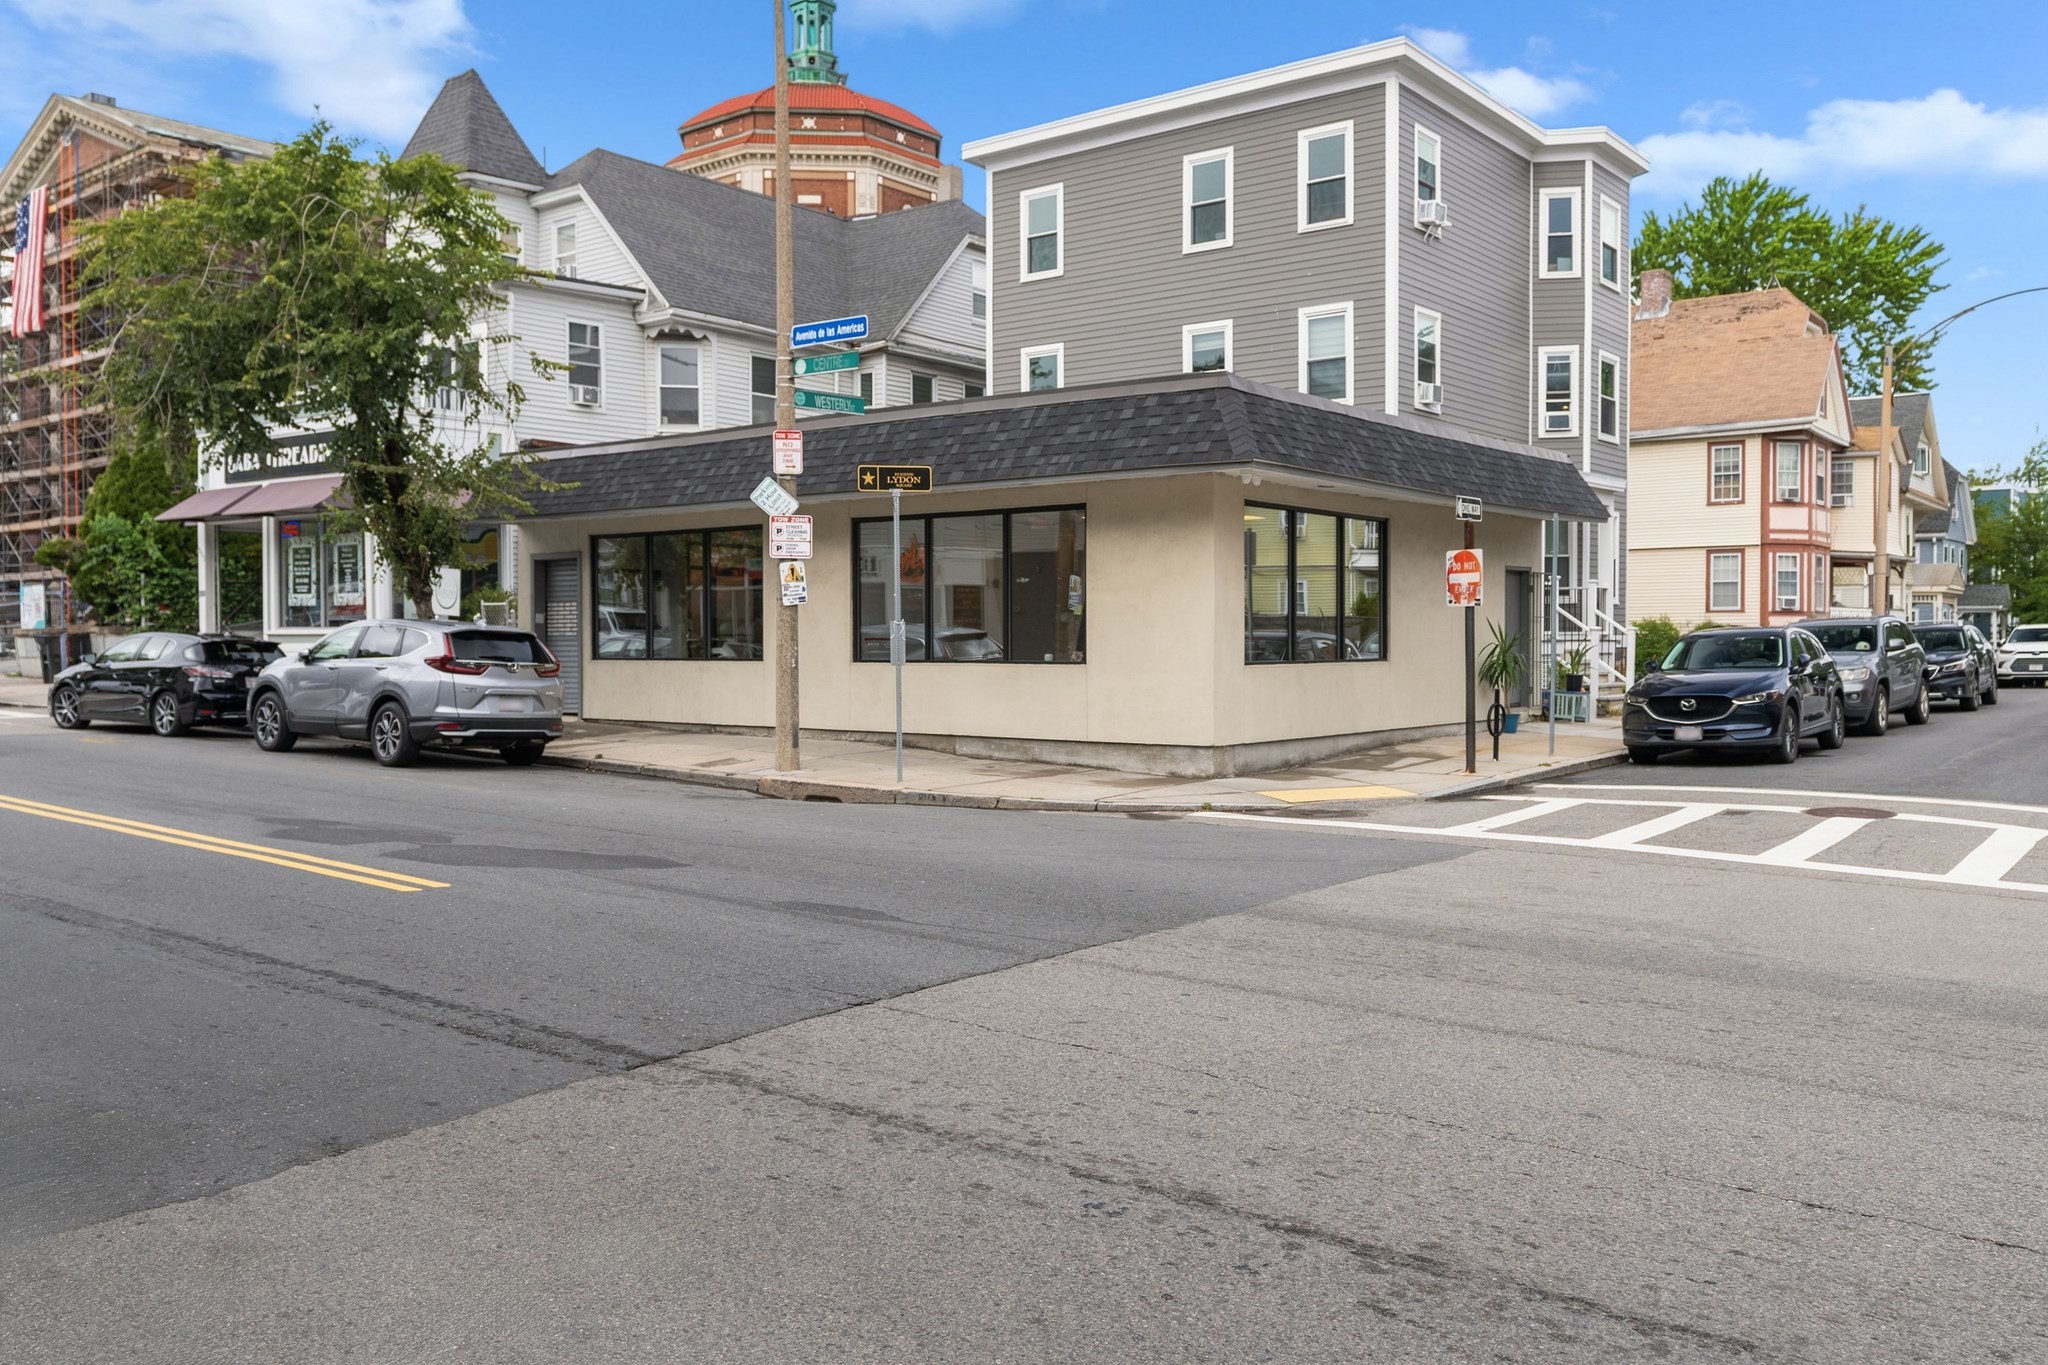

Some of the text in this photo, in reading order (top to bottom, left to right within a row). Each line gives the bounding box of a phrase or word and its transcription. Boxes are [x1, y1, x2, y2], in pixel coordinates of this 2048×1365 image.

[795, 323, 864, 342] Avenida de las Americas
[813, 355, 843, 371] CENTRE
[815, 395, 851, 411] WESTERLY
[887, 476, 921, 484] LYDON
[753, 480, 774, 501] Parking
[765, 487, 777, 501] Hour
[768, 493, 783, 509] Limit
[1462, 503, 1479, 513] ONE WAY
[1453, 561, 1476, 571] DO NOT
